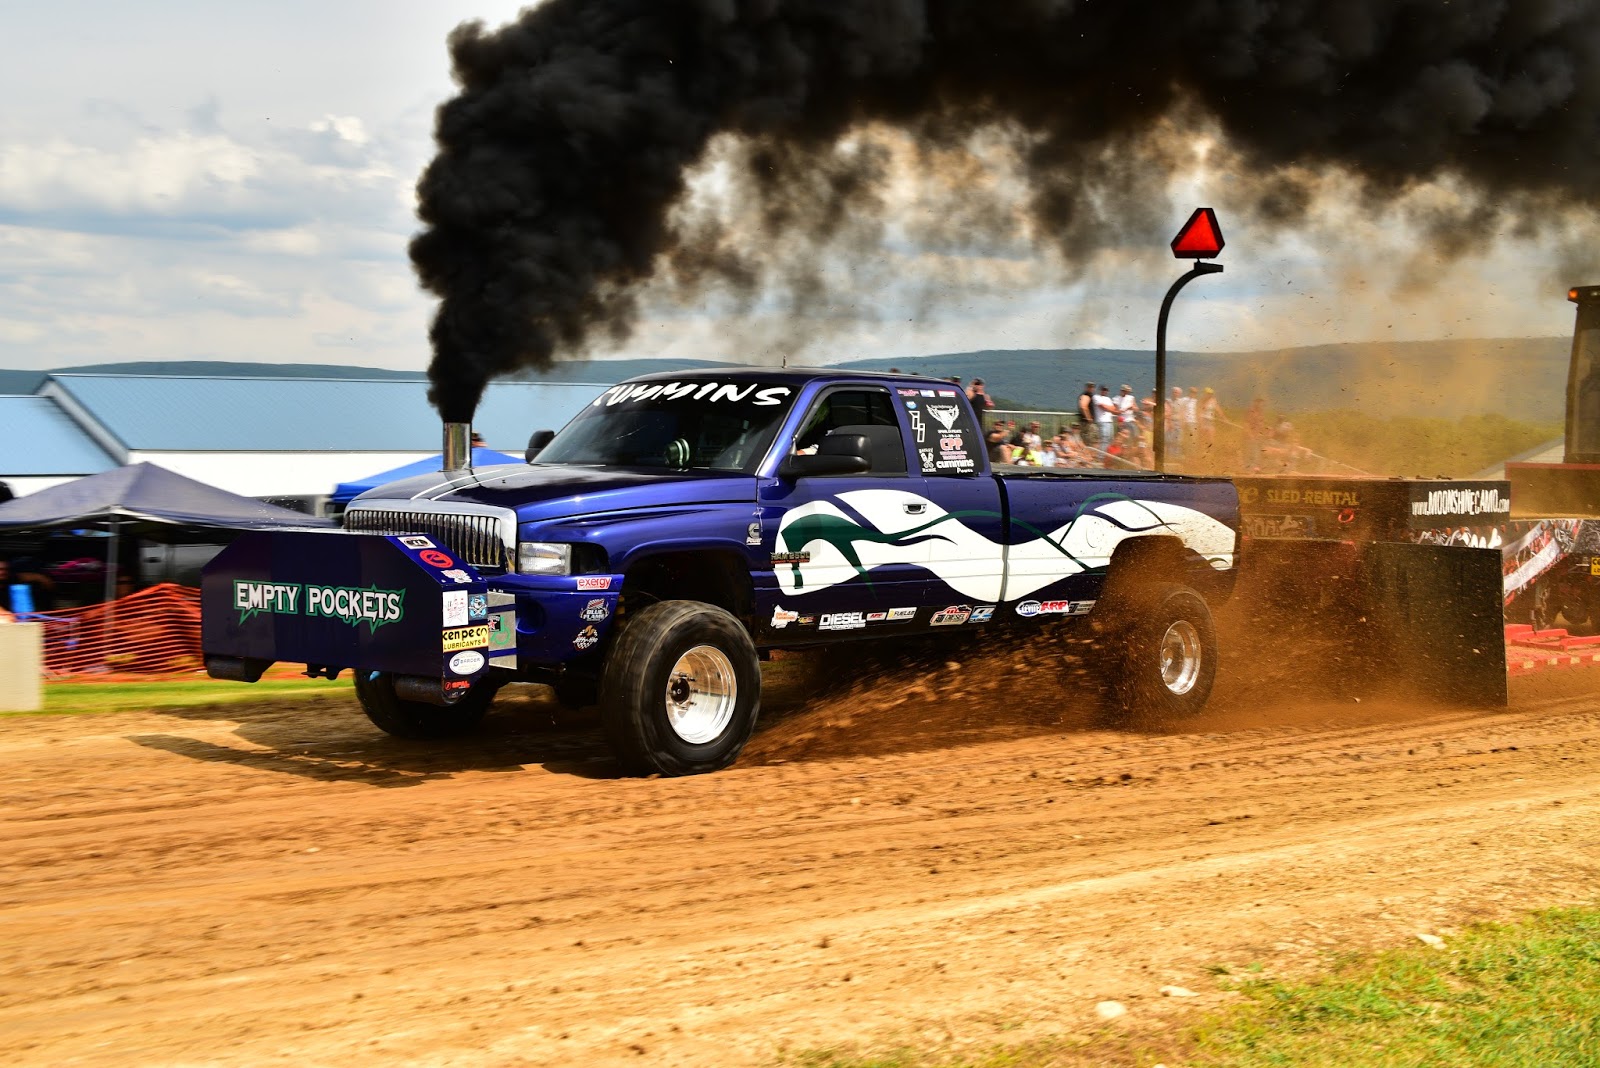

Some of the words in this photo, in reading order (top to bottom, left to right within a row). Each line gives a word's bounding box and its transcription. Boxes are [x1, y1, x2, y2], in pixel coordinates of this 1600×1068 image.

[1265, 489, 1300, 503] SLED
[1304, 489, 1360, 506] RENTAL
[578, 577, 611, 589] exergy
[235, 582, 299, 612] EMPTY
[307, 586, 401, 623] POCKETS
[1040, 600, 1068, 612] ARP
[819, 612, 866, 626] DIESEL
[443, 639, 482, 651] LUBRICANTS
